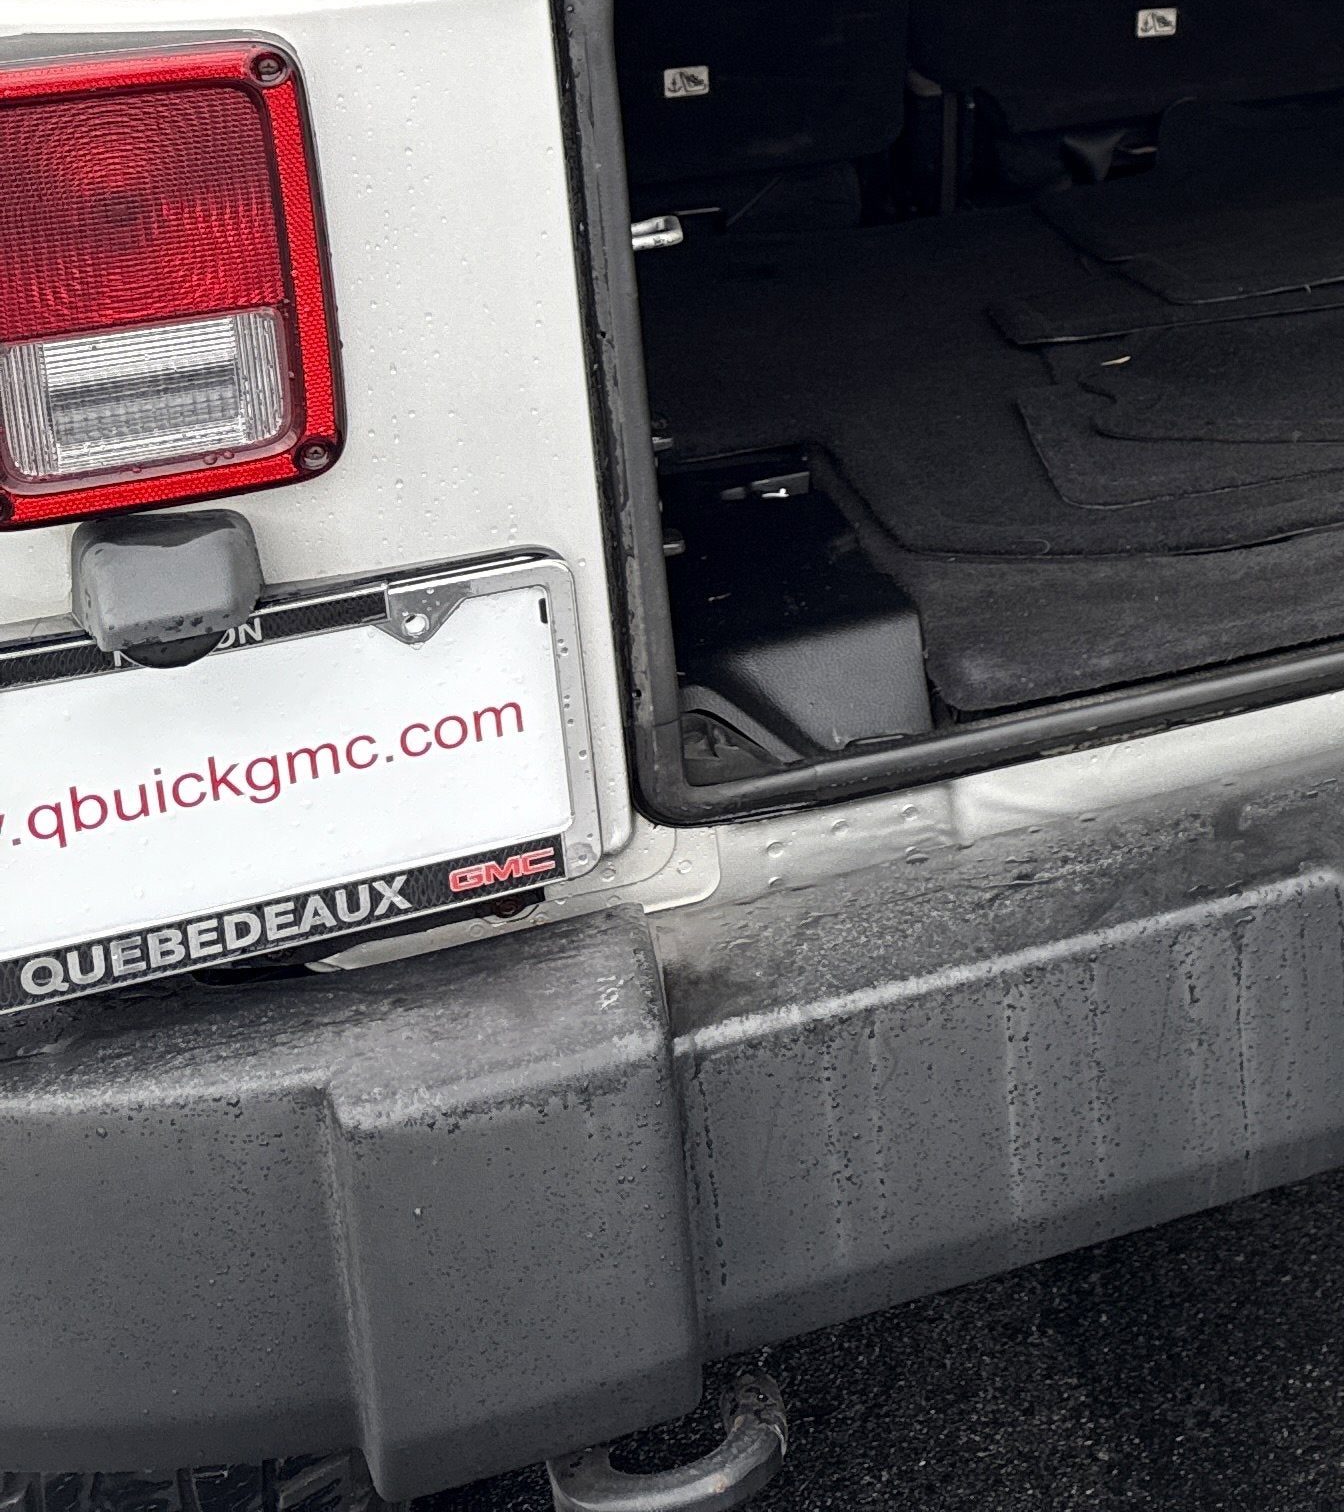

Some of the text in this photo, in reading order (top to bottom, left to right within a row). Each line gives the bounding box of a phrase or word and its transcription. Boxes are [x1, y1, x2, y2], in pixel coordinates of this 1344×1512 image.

[0, 701, 525, 849] .qbuickgmc.com
[19, 846, 556, 996] QUEBEDEAUX GMC
